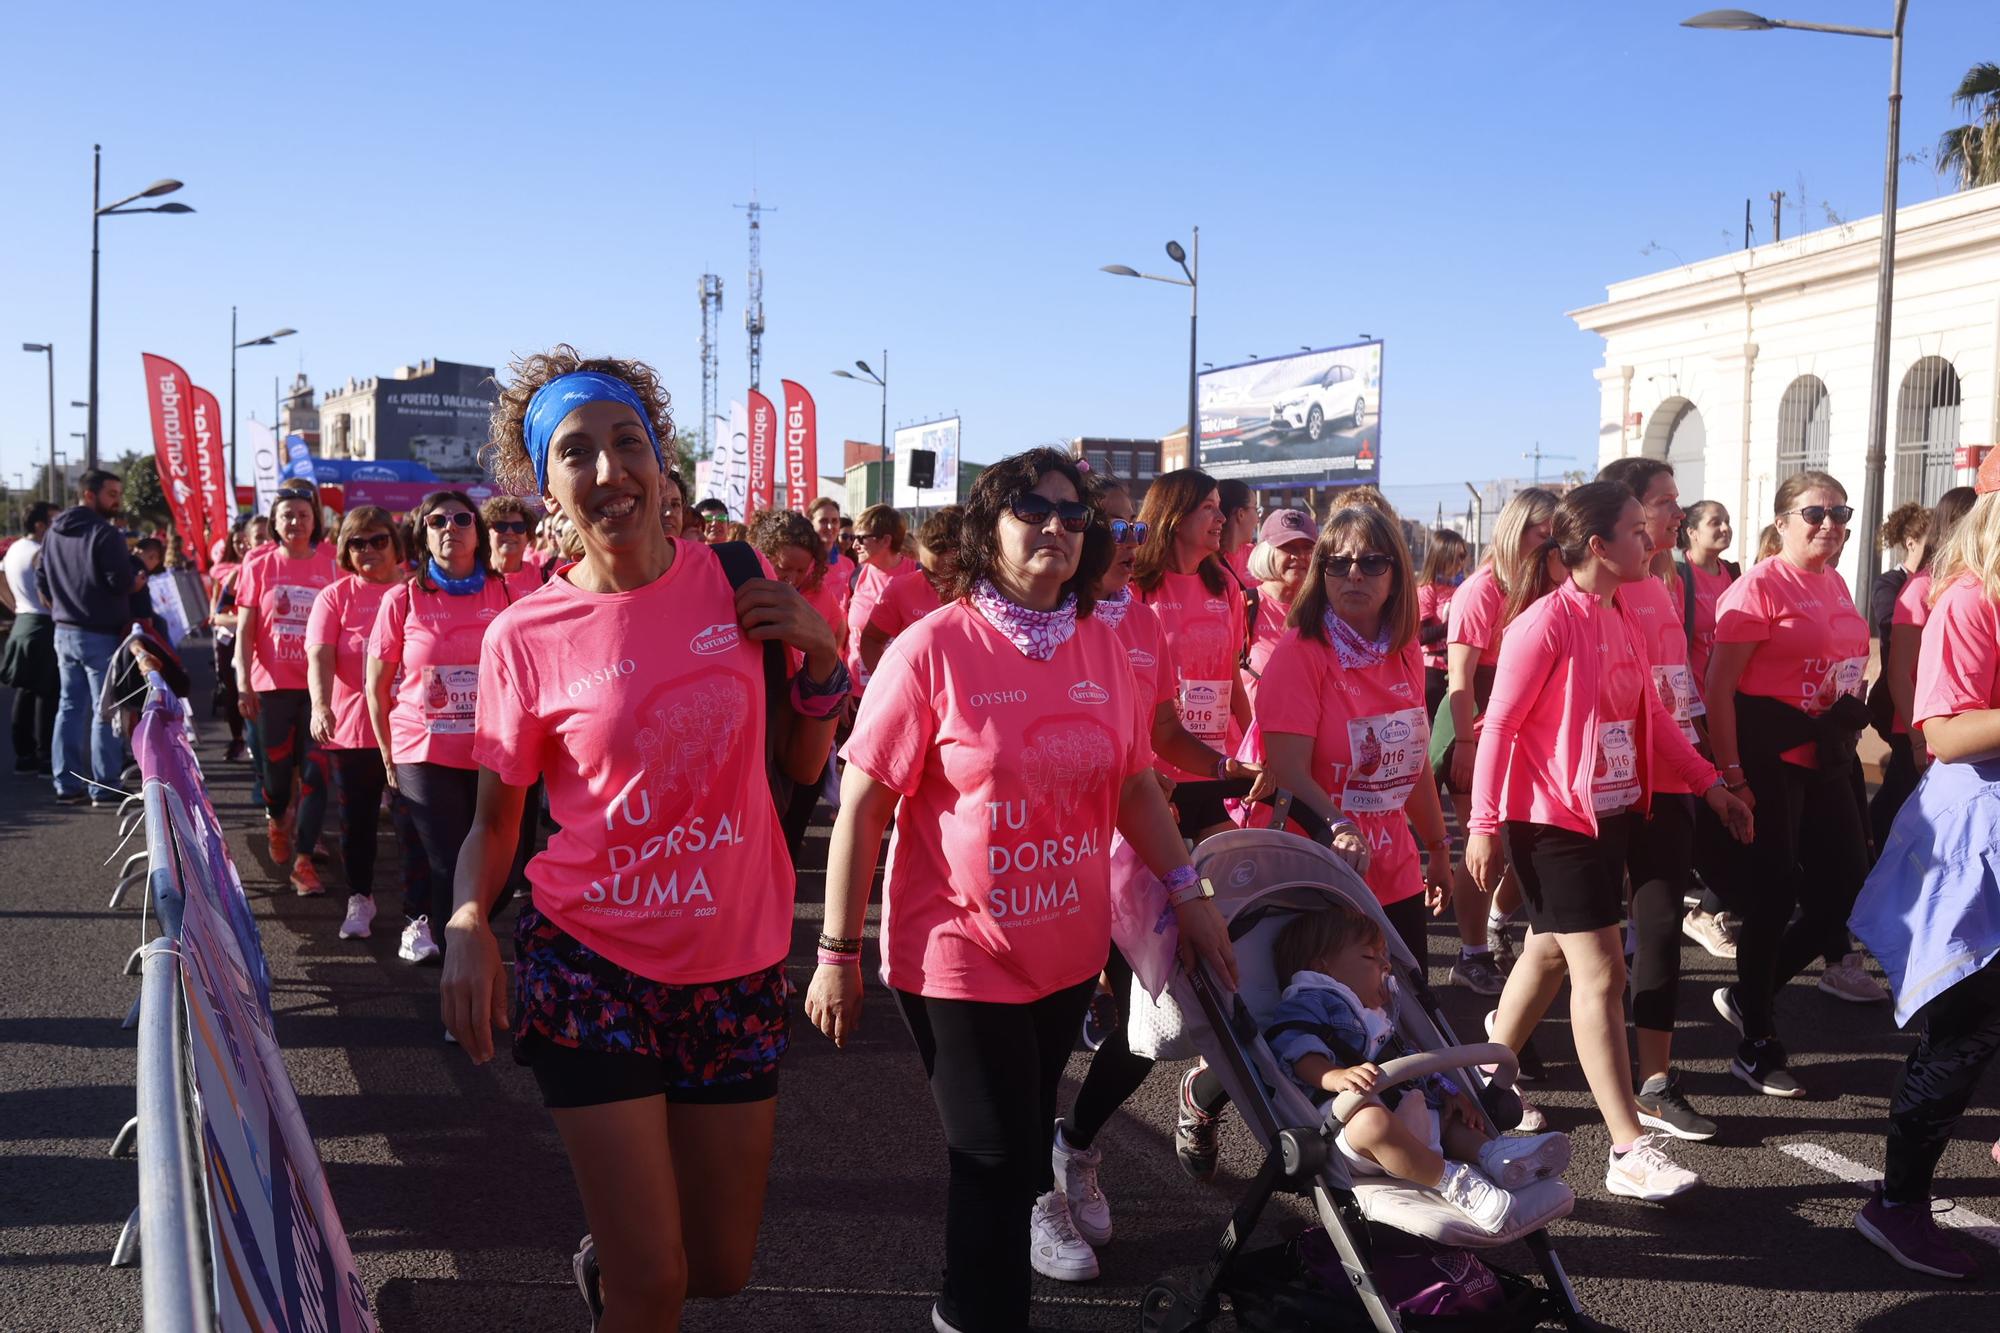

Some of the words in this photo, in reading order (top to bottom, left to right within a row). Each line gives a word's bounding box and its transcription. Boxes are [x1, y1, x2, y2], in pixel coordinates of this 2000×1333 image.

[401, 394, 440, 406] PUERTO
[568, 659, 636, 698] OYSHO
[451, 693, 477, 701] 016
[970, 689, 1027, 707] OYSHO
[1187, 710, 1212, 721] 016
[1190, 722, 1206, 730] 5913
[1382, 749, 1405, 766] 016
[1608, 754, 1630, 769] 016
[1385, 767, 1398, 778] 2434
[1353, 795, 1383, 804] OYSHO
[985, 800, 1026, 831] TU
[607, 810, 744, 873] DORSAL
[989, 828, 1098, 874] DORSAL
[583, 867, 713, 907] SUMA
[989, 878, 1079, 918] SUMA
[582, 904, 627, 918] CARRERA
[625, 910, 637, 918] DE
[652, 909, 682, 918] MUJER
[694, 907, 716, 917] 2023
